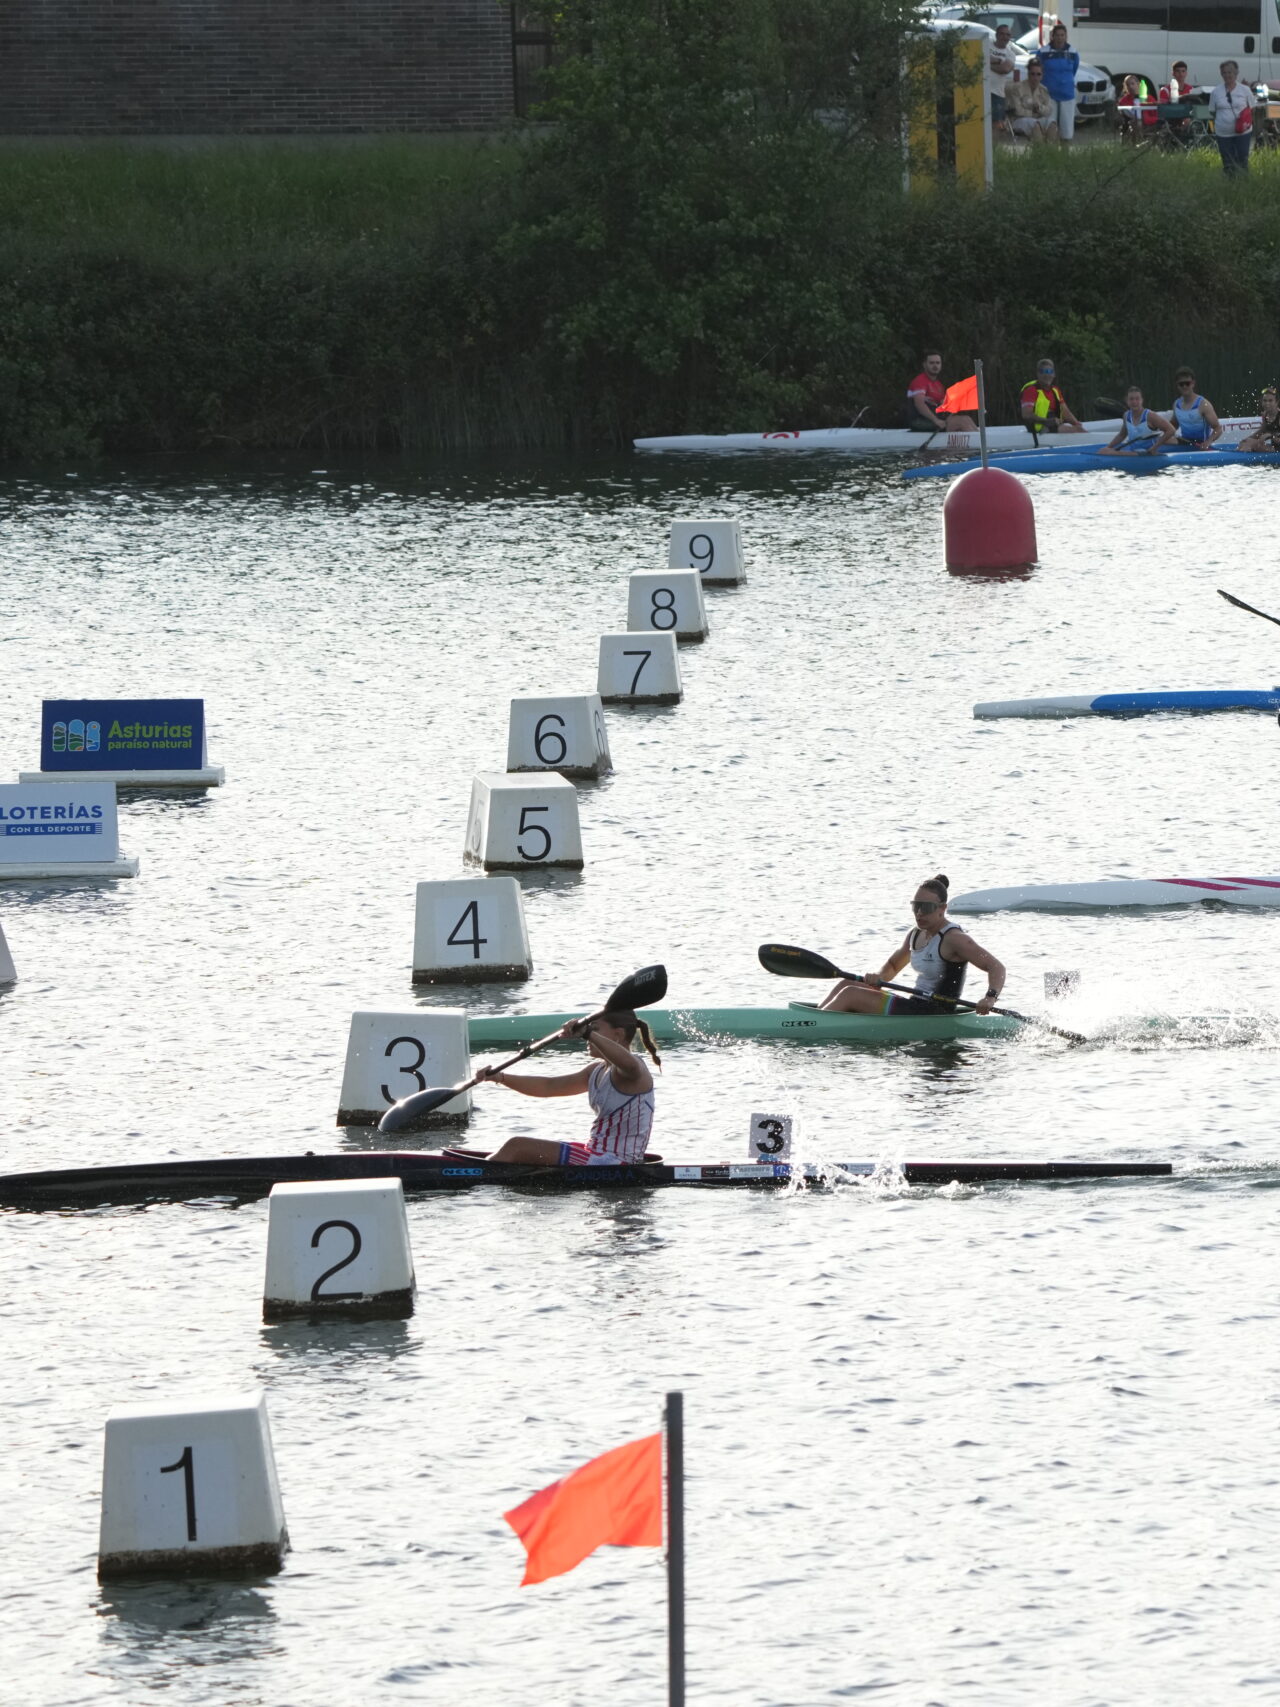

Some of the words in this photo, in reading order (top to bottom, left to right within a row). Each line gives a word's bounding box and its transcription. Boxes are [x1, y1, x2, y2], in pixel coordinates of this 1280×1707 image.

[688, 534, 714, 573] 9
[650, 588, 678, 631] 8
[622, 650, 652, 695] 7
[108, 719, 192, 738] Asturias
[108, 739, 149, 751] paraíso
[152, 739, 192, 749] natural
[534, 714, 567, 765] 6
[0, 802, 103, 820] LOTERÍAS
[47, 825, 91, 833] DEPORTE
[516, 806, 552, 861] 5
[446, 900, 488, 959] 4
[381, 1036, 427, 1105] 3
[756, 1119, 785, 1154] 3
[442, 1168, 484, 1176] NELO
[310, 1220, 364, 1301] 2
[160, 1446, 197, 1542] 1
